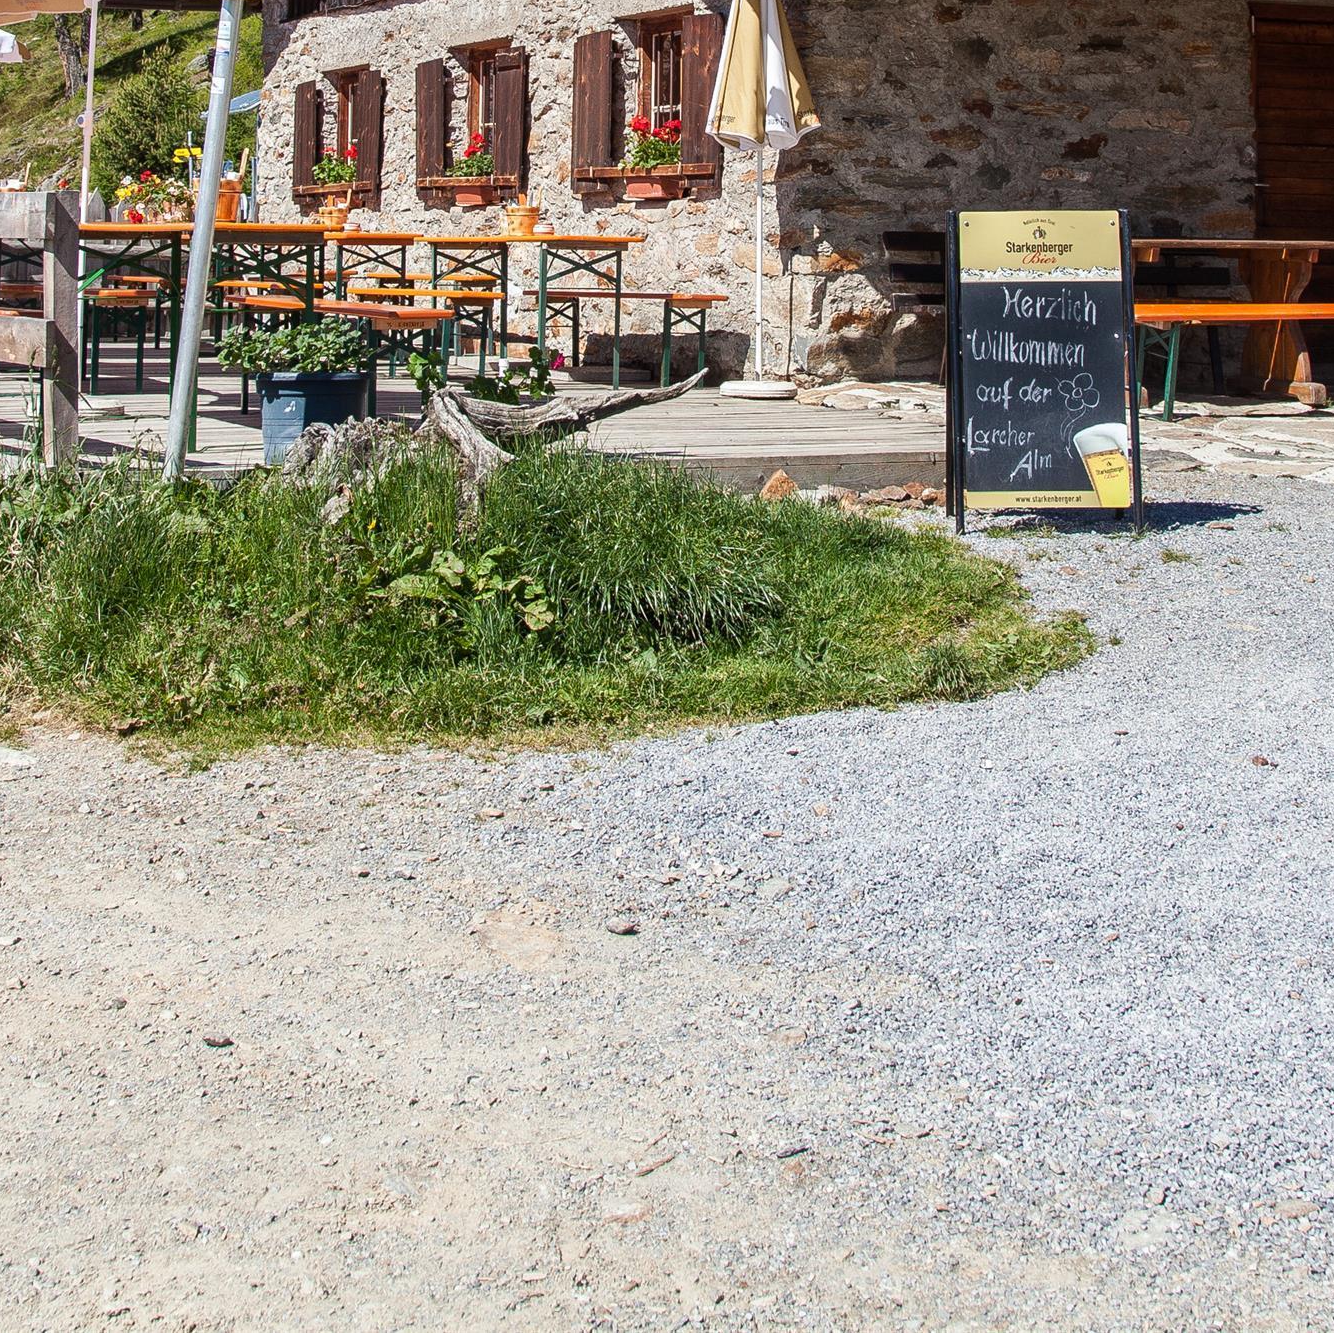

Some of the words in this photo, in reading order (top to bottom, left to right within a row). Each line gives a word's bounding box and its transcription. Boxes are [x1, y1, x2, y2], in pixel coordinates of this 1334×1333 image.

[1006, 241, 1074, 256] Starkenberger
[1022, 251, 1058, 265] Bier
[1000, 286, 1097, 326] Herzlich
[971, 328, 1085, 367] Willkommen
[976, 377, 1014, 411] auf
[1019, 378, 1052, 403] der
[967, 416, 1036, 453] Larcher
[1009, 449, 1052, 483] Alm
[1015, 495, 1082, 504] www.starkenberger.at
